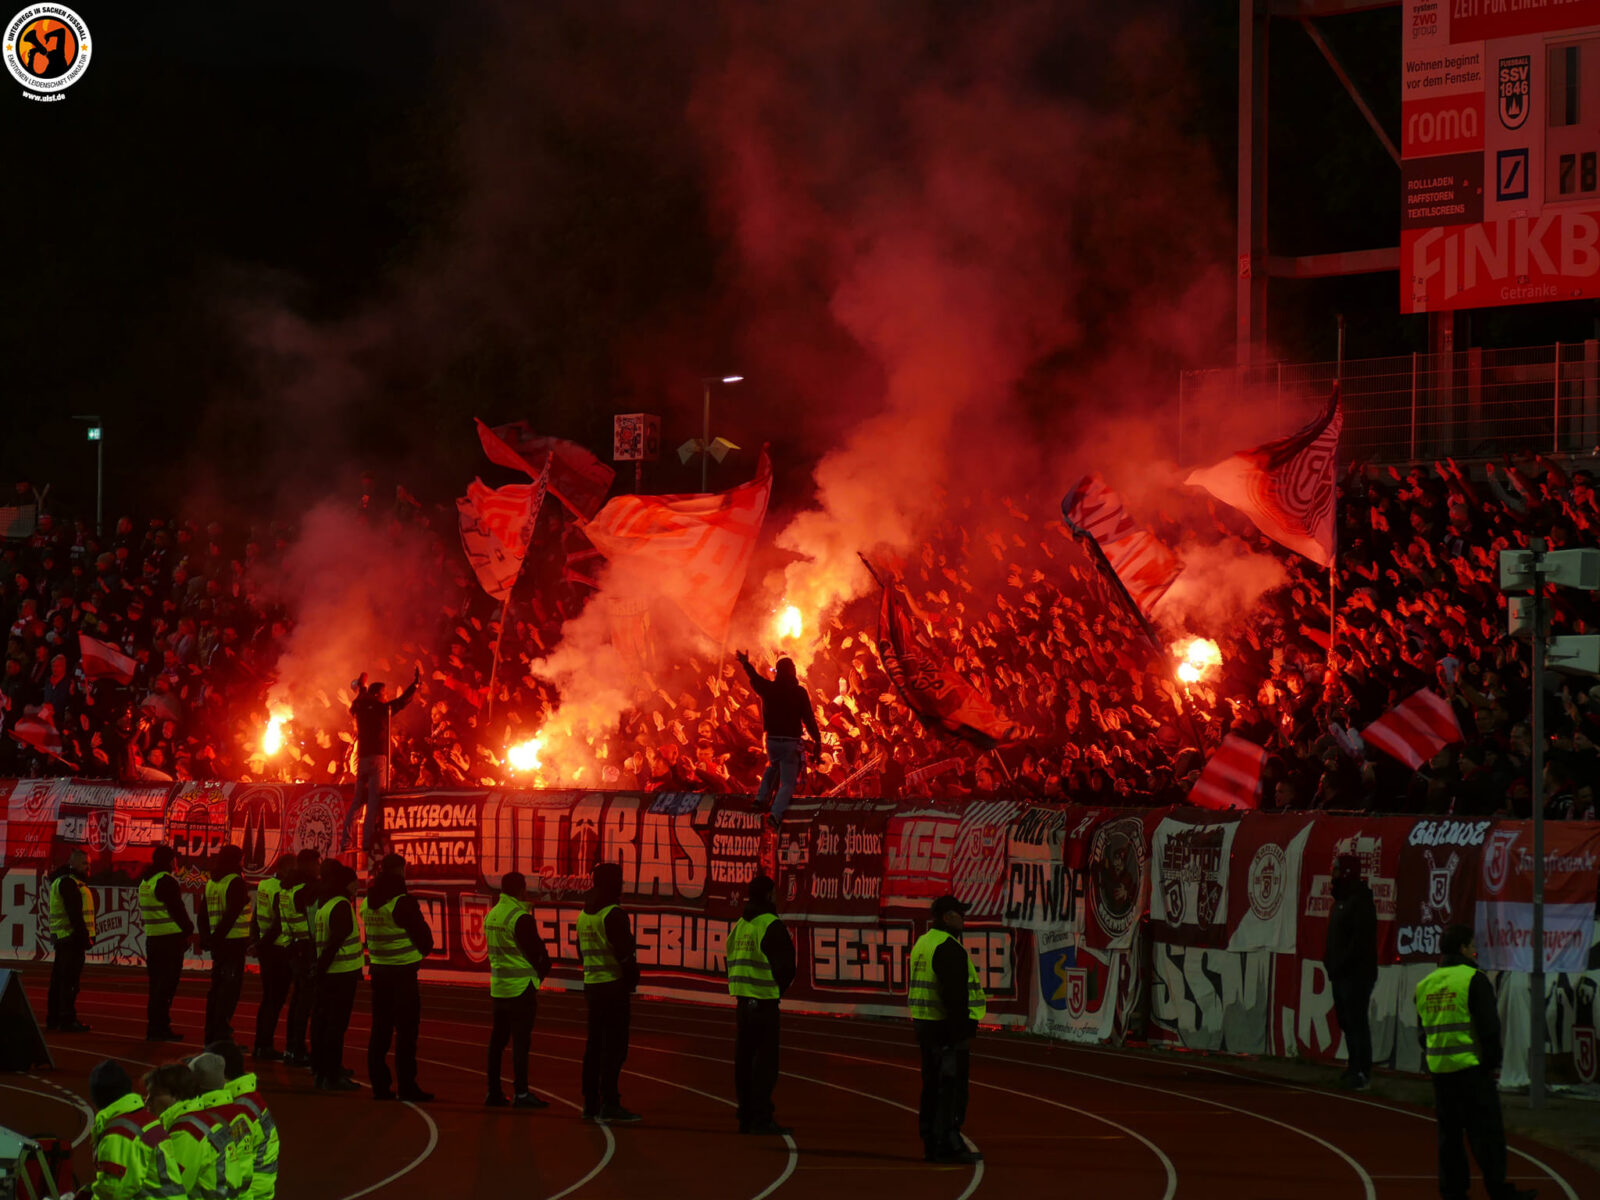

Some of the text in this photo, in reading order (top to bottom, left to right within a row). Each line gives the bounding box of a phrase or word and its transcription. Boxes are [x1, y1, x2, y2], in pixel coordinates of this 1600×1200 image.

[1413, 3, 1438, 13] system
[1412, 25, 1438, 40] group
[1406, 54, 1480, 73] Wohnen beginnt
[1406, 70, 1481, 89] vor dem Fenster.
[1500, 66, 1529, 83] SSV
[1500, 80, 1529, 97] 1846
[1408, 106, 1478, 145] roma
[1407, 190, 1455, 205] RAFFSTOREN
[1407, 204, 1465, 219] TEXTILSCREENS
[1501, 283, 1559, 301] Getränke
[383, 804, 478, 830] RATISBONA
[712, 833, 762, 857] STADION
[816, 824, 840, 855] Die
[888, 821, 959, 873] JGS
[394, 841, 477, 866] FANATICA
[842, 868, 882, 900] Tower
[813, 927, 910, 984] SEIT
